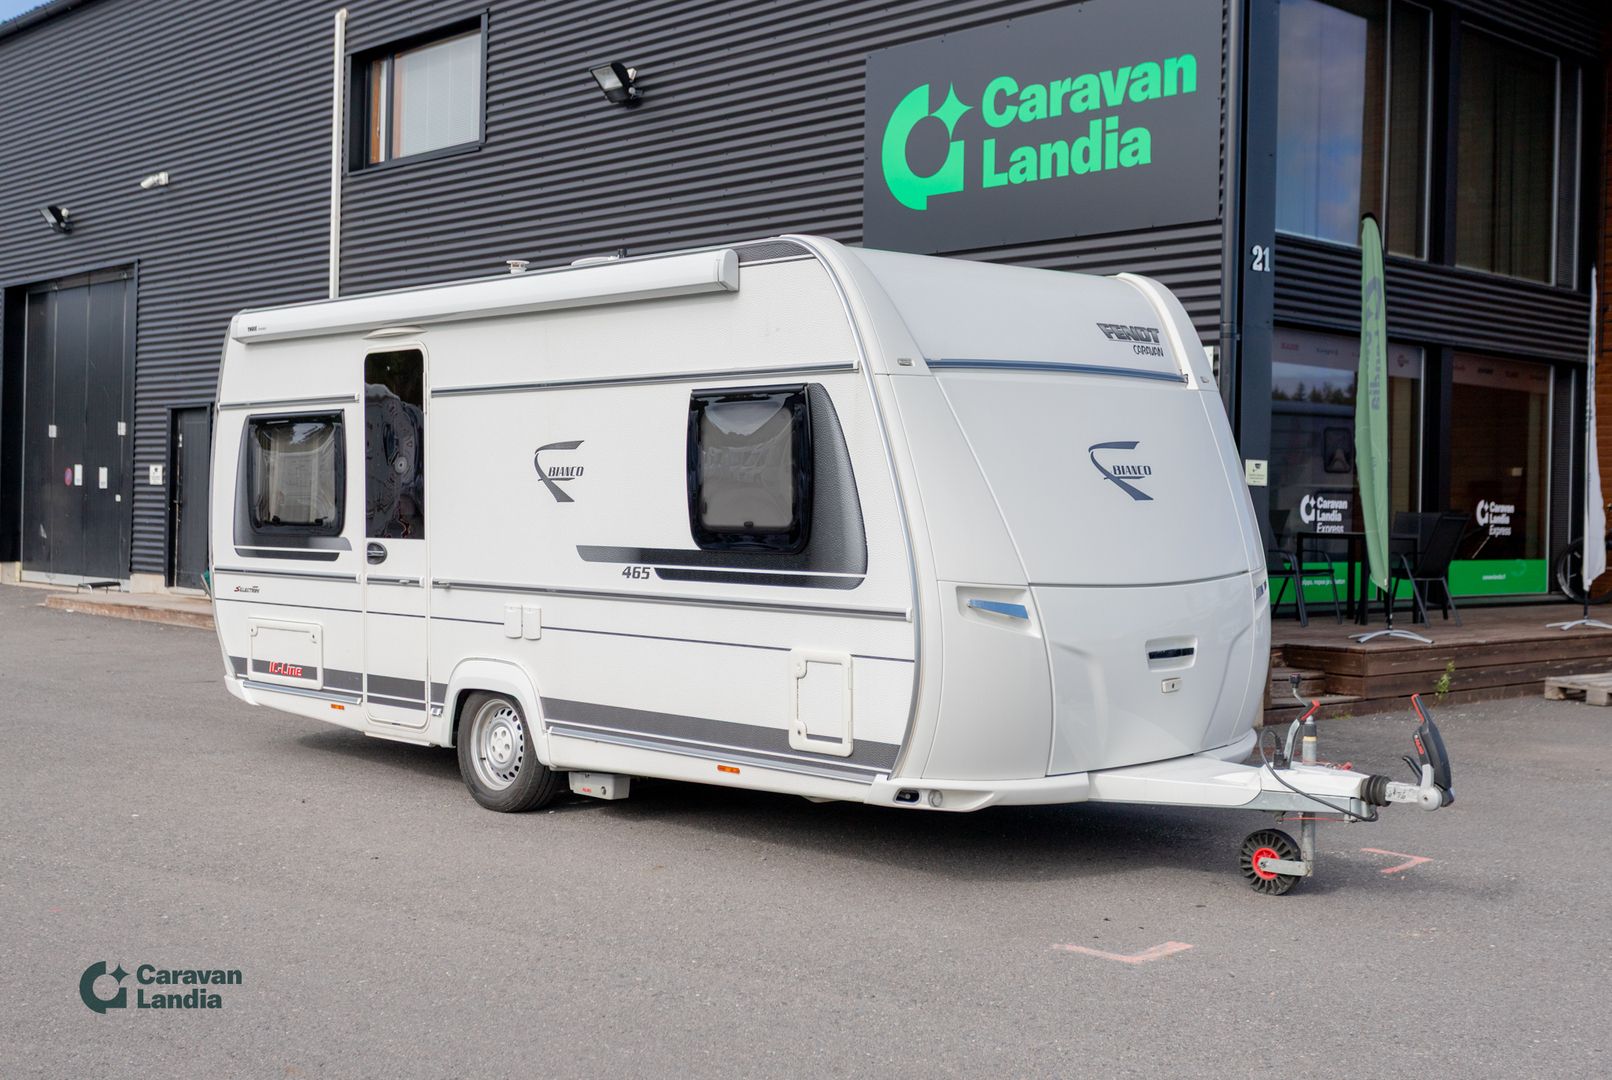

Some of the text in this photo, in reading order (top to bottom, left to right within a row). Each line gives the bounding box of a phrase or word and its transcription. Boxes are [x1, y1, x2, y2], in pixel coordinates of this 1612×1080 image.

[982, 53, 1198, 128] Caravan
[982, 116, 1152, 189] Landia
[1251, 244, 1271, 272] 21
[1096, 322, 1160, 343] FENDT
[548, 466, 584, 477] BIANCO
[1112, 465, 1152, 475] BIANCO
[1316, 496, 1348, 509] Caravan
[1316, 510, 1342, 521] Landia
[622, 566, 651, 579] 465
